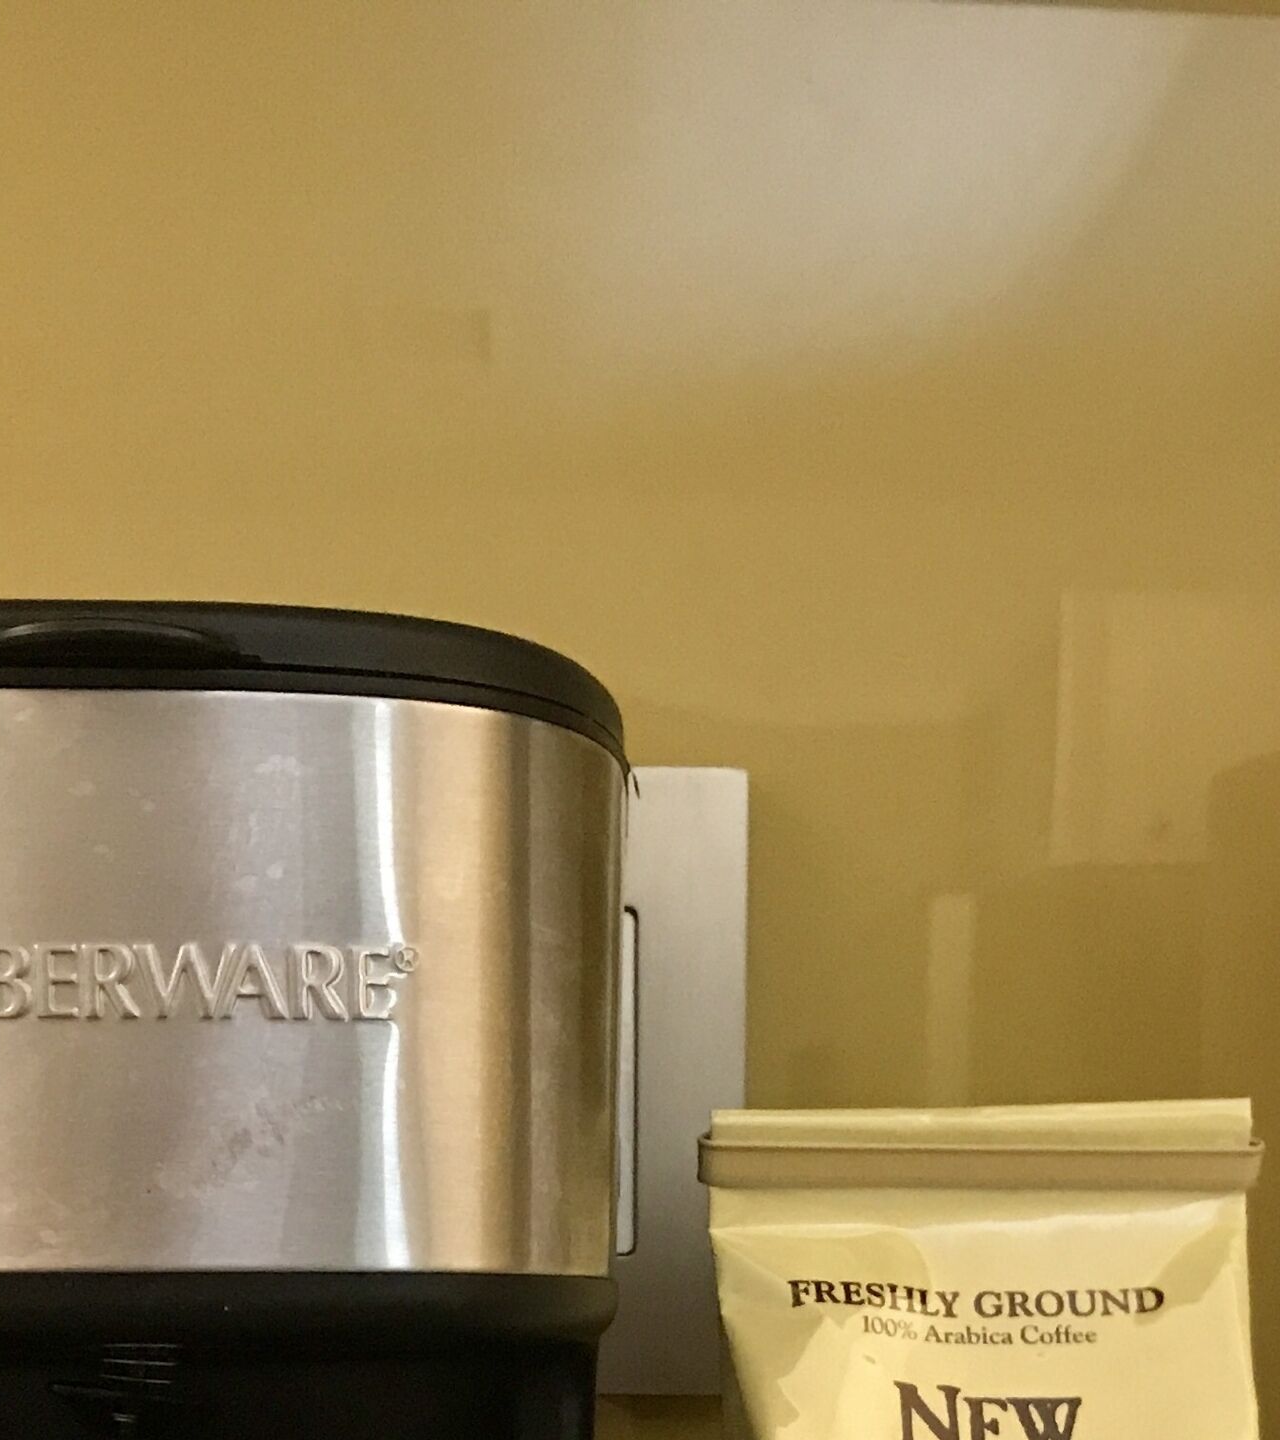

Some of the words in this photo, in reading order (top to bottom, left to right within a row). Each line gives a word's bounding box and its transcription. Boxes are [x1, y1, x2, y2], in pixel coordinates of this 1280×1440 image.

[788, 1279, 960, 1318] FRESHLY
[973, 1286, 1165, 1318] GROUND
[861, 1315, 918, 1340] 100%
[924, 1325, 1013, 1345] Arabica
[1020, 1324, 1098, 1345] Coffee
